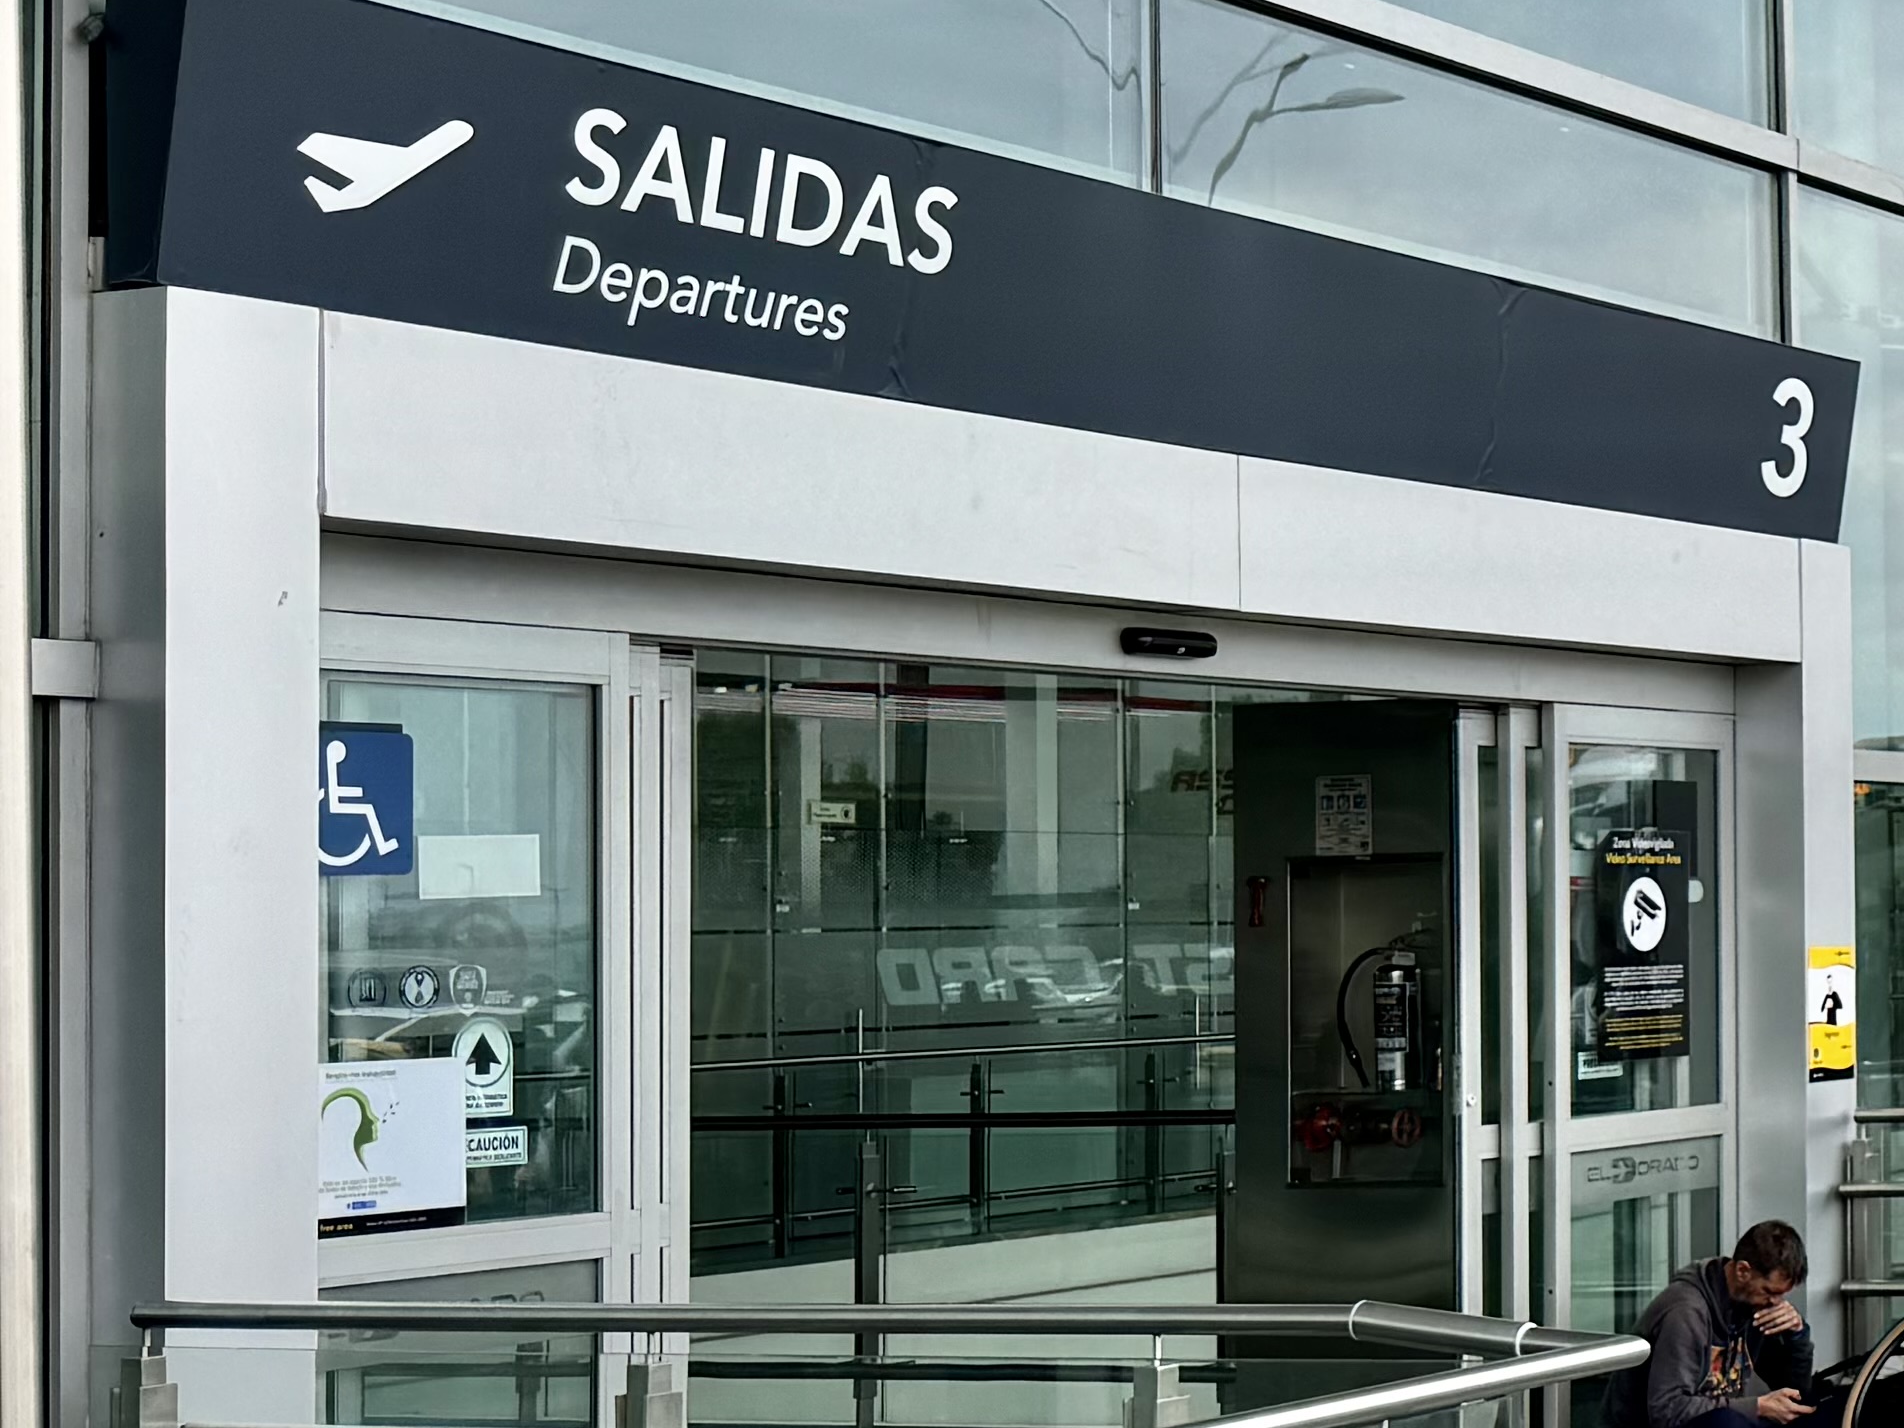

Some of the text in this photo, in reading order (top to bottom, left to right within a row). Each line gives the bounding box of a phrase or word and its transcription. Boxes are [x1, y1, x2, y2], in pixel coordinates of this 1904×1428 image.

[565, 109, 958, 275] SALIDAS
[553, 235, 849, 345] Departures
[1761, 378, 1813, 497] 3
[465, 1132, 519, 1152] CAUCIÓN
